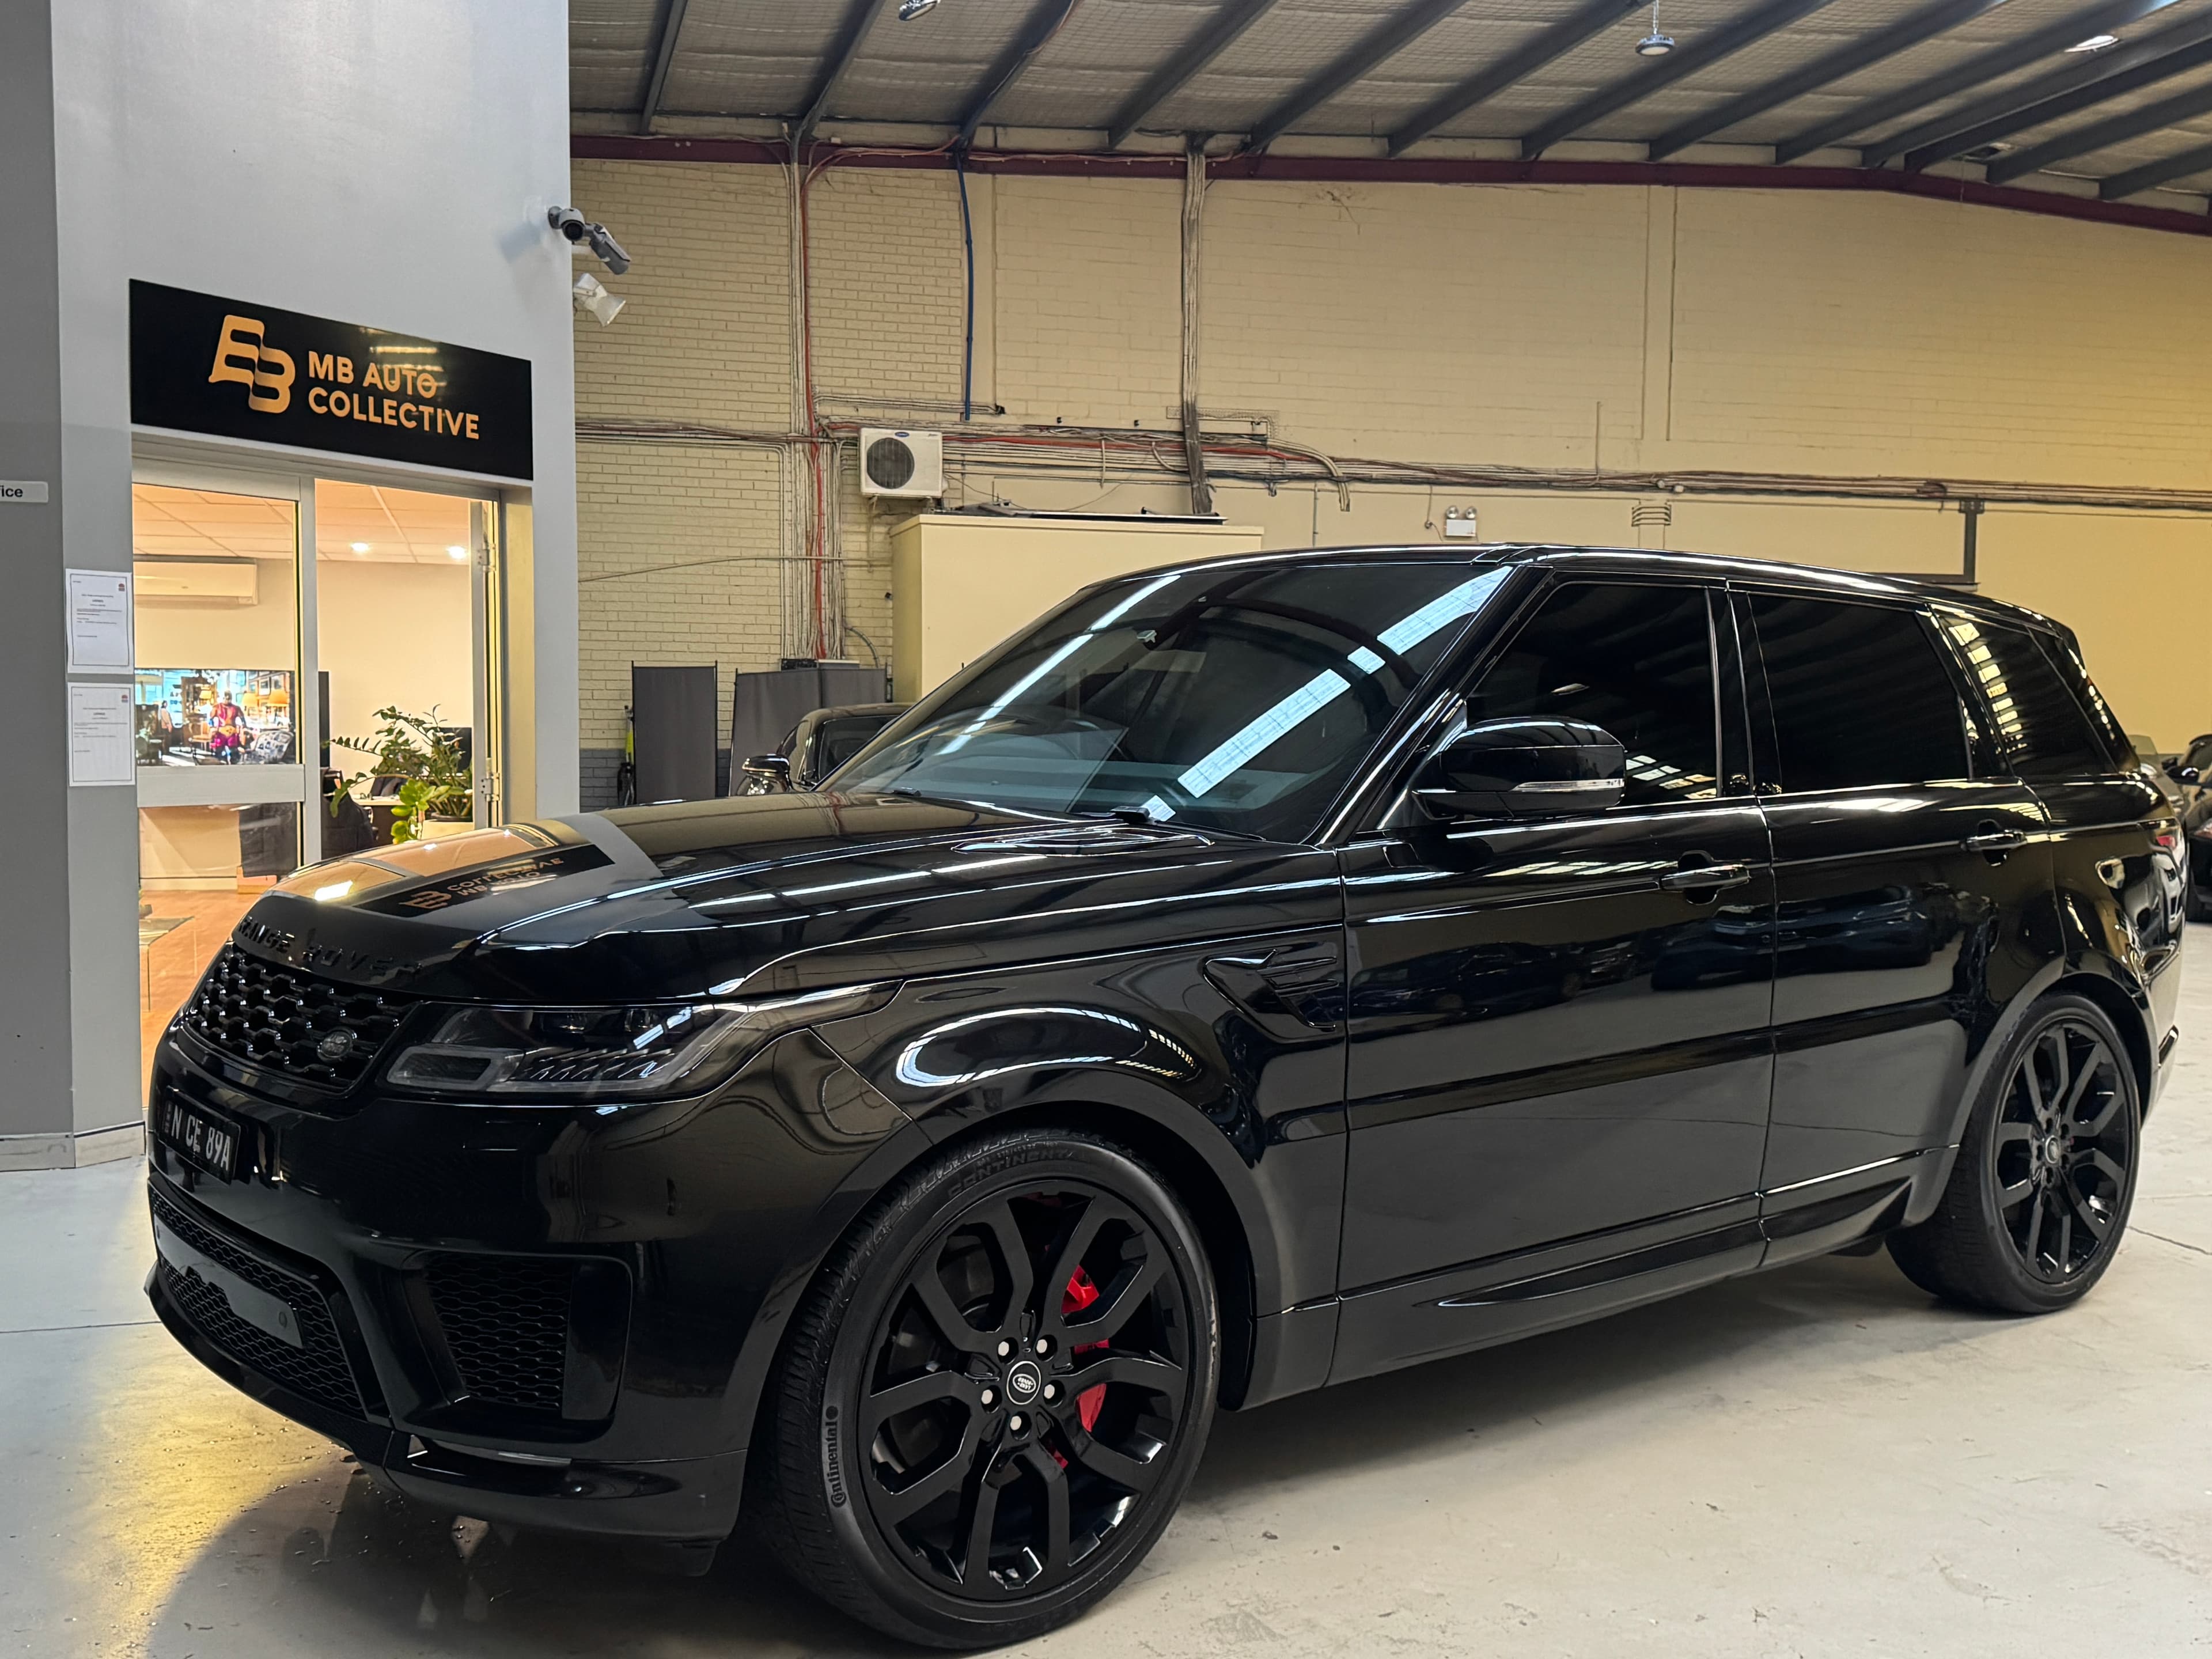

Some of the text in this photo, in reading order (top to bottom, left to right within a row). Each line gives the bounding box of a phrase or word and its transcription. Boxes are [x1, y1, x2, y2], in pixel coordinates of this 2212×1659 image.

[308, 351, 437, 399] MB AUTO
[308, 387, 479, 440] COLLECTIVE
[0, 485, 23, 498] ice
[825, 1421, 847, 1508] Continental
